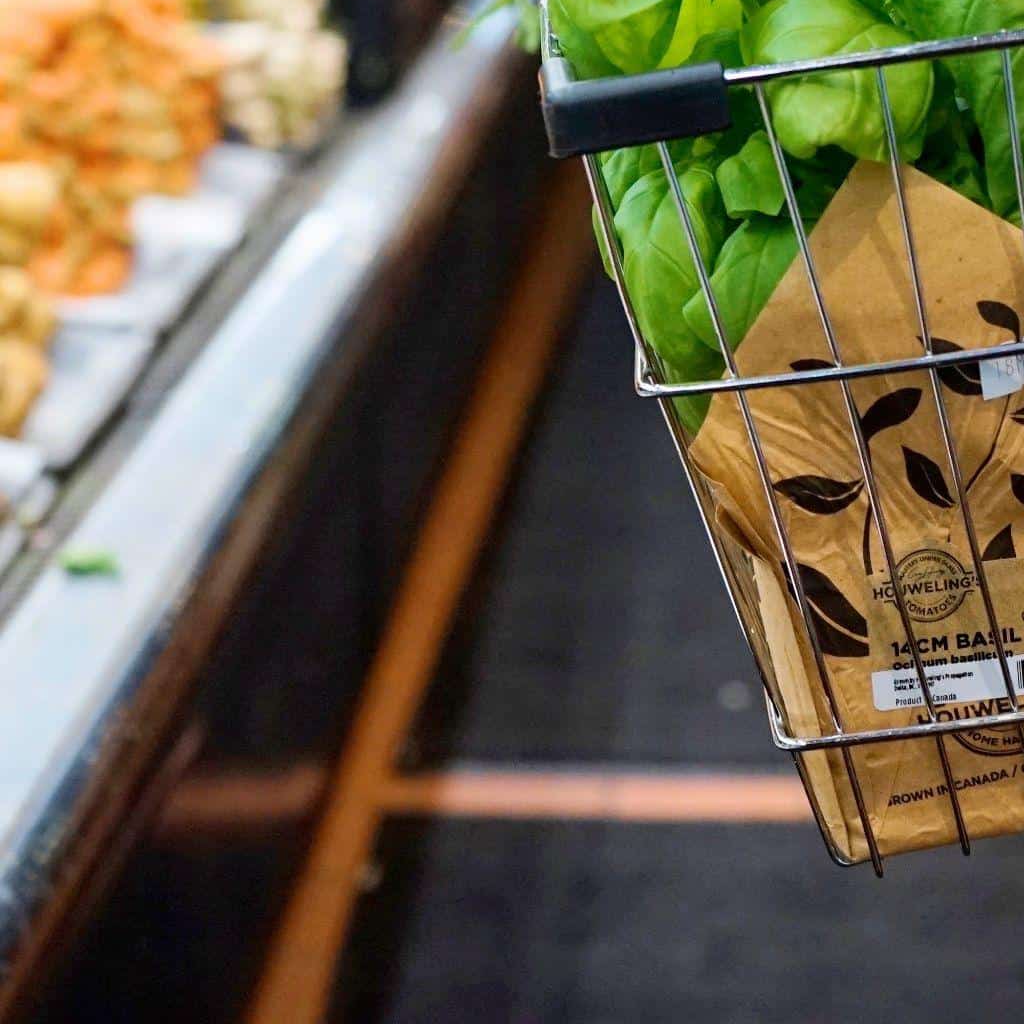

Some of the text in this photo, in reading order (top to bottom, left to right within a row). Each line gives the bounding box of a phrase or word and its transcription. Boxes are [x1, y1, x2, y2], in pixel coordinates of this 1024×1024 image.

[891, 635, 949, 657] 14CM
[895, 696, 922, 707] Product
[954, 768, 1010, 791] CANADA
